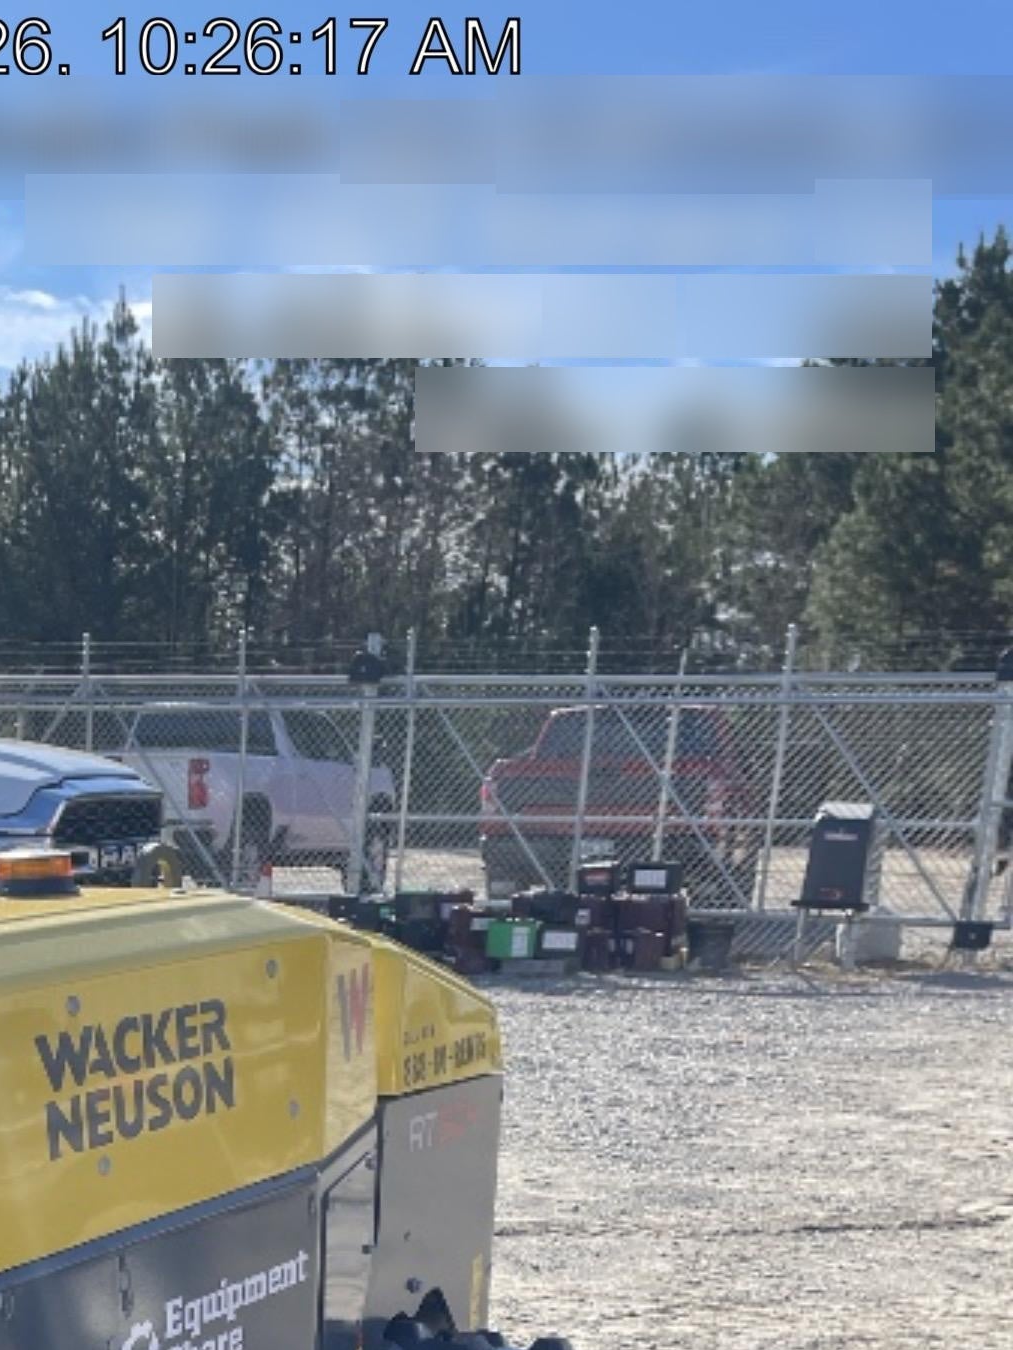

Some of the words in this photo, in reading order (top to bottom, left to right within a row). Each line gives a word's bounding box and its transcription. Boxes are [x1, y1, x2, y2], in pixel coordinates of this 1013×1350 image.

[35, 999, 231, 1092] WACKER
[46, 1056, 236, 1161] NEUSON
[164, 1250, 309, 1339] Equipment
